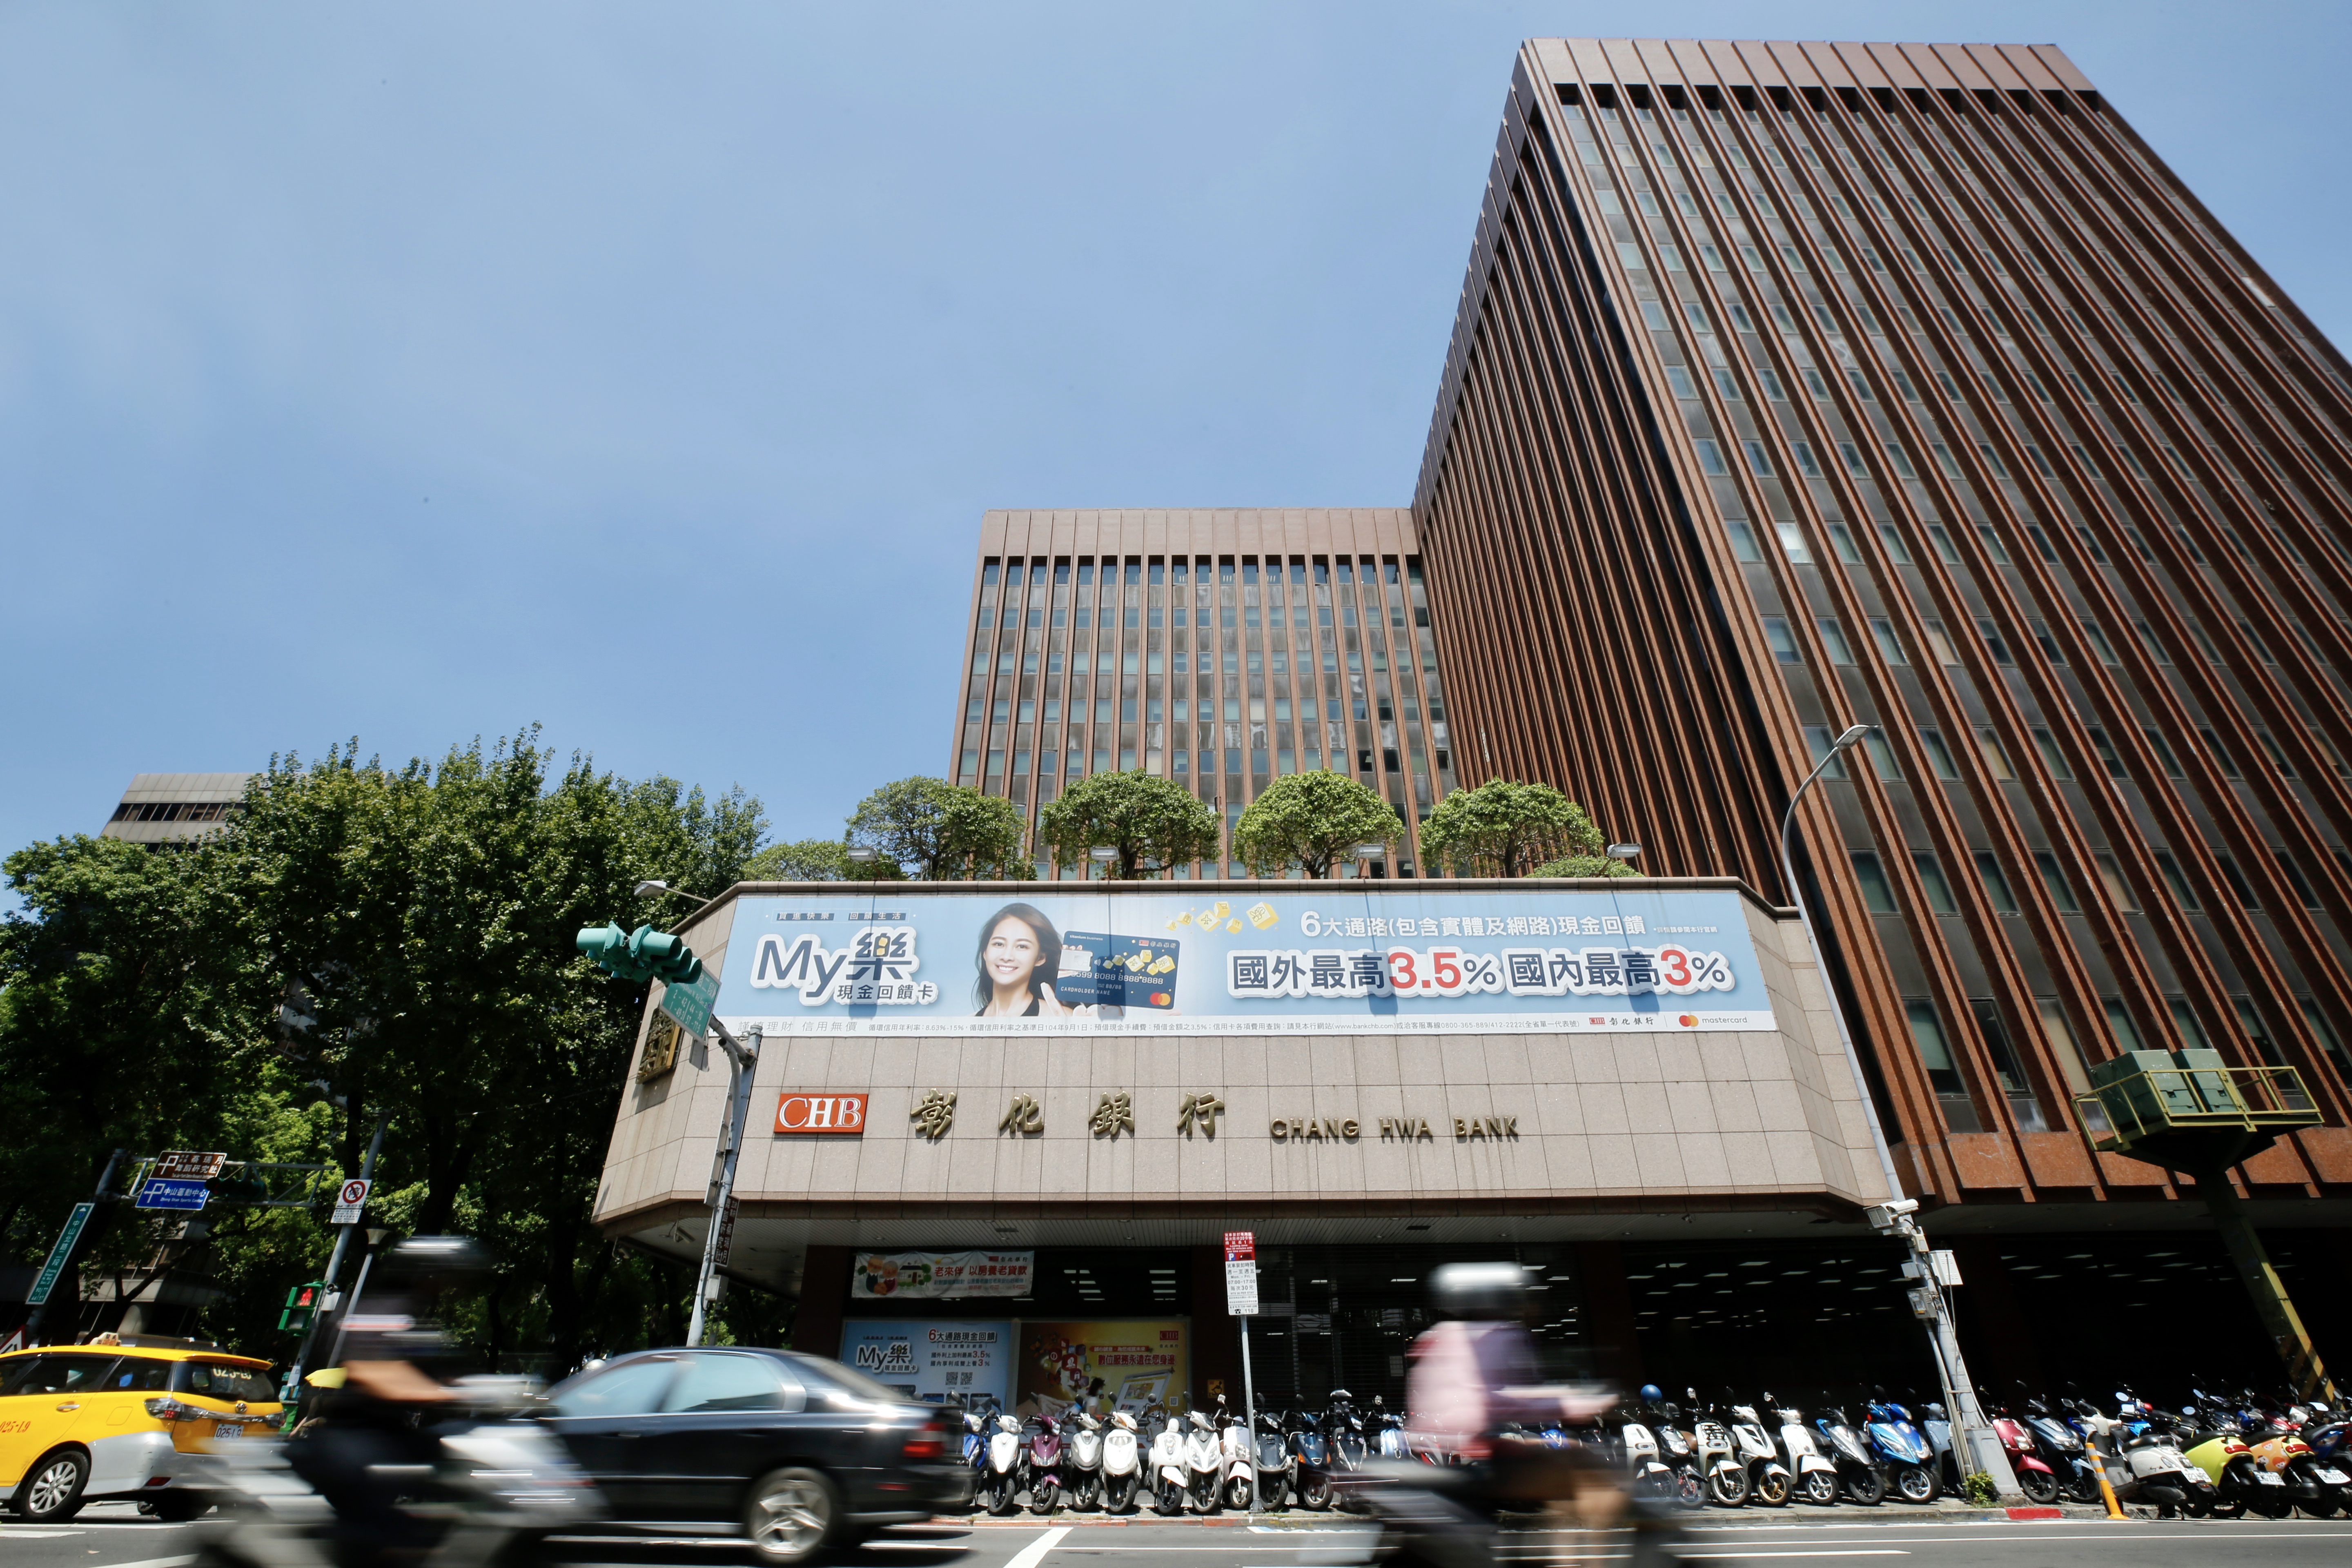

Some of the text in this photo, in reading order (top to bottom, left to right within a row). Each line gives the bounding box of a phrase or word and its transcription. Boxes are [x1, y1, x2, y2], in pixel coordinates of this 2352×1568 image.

[779, 912, 901, 920] 買進快樂 回饋生活
[1301, 911, 1646, 937] 6大通路(包含實體及網路)現金回饋
[1233, 949, 1725, 989] 國外最高3.5% 國內最高3%
[837, 984, 935, 1000] 現金回饋卡
[802, 1021, 858, 1031] 信用無價
[1609, 1015, 1654, 1026] 彰化銀行
[779, 1097, 862, 1129] CHB
[911, 1088, 1225, 1139] 彰化銀行
[1271, 1117, 1517, 1137] CHANG HWA BANK
[163, 1187, 206, 1198] 中山運動中心
[51, 1220, 80, 1266] 中山北路二段
[934, 1265, 1028, 1277] 老來伴 以房養老貸款
[929, 1329, 995, 1341] 6大通路現金回饋
[1160, 1331, 1178, 1340] CHB
[858, 1345, 909, 1370] My樂
